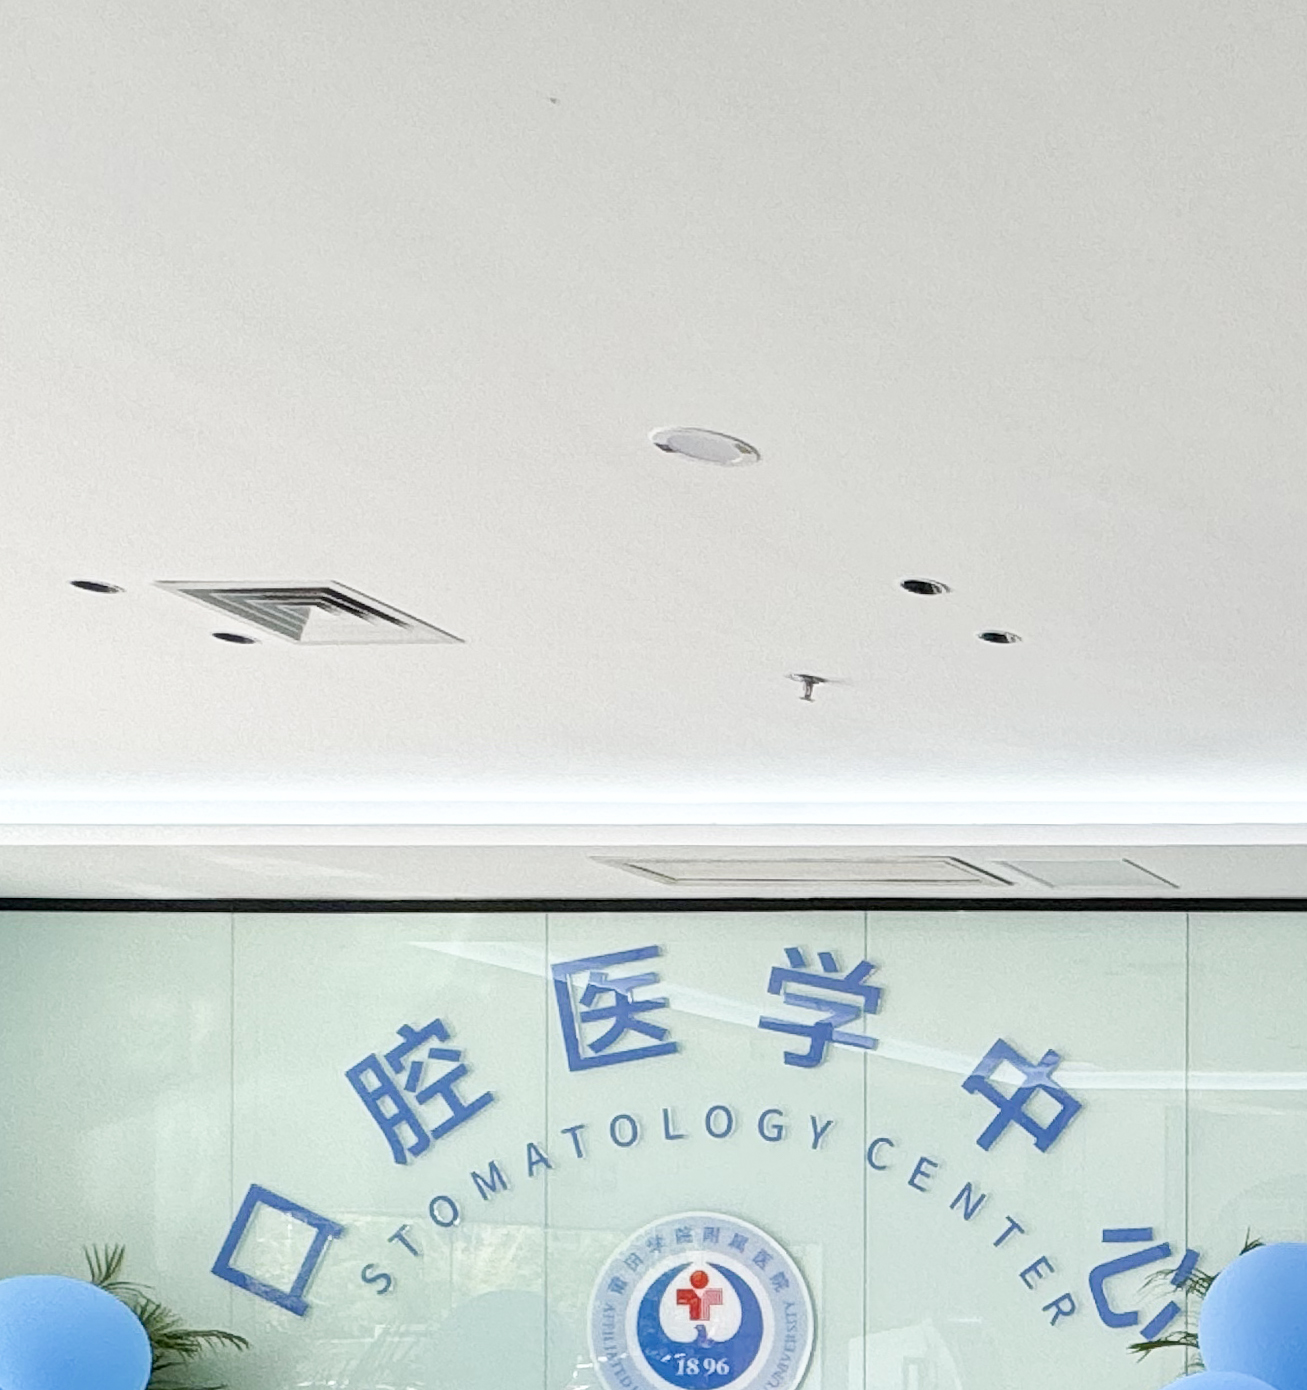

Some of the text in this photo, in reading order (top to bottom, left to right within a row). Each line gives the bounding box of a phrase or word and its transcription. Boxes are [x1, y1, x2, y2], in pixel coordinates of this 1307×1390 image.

[211, 945, 1199, 1340] 口腔医学中心
[360, 1104, 1078, 1326] STOMATOLOGY CENTER
[675, 1357, 730, 1376] 1896
[768, 1301, 798, 1389] UNIVERSITY
